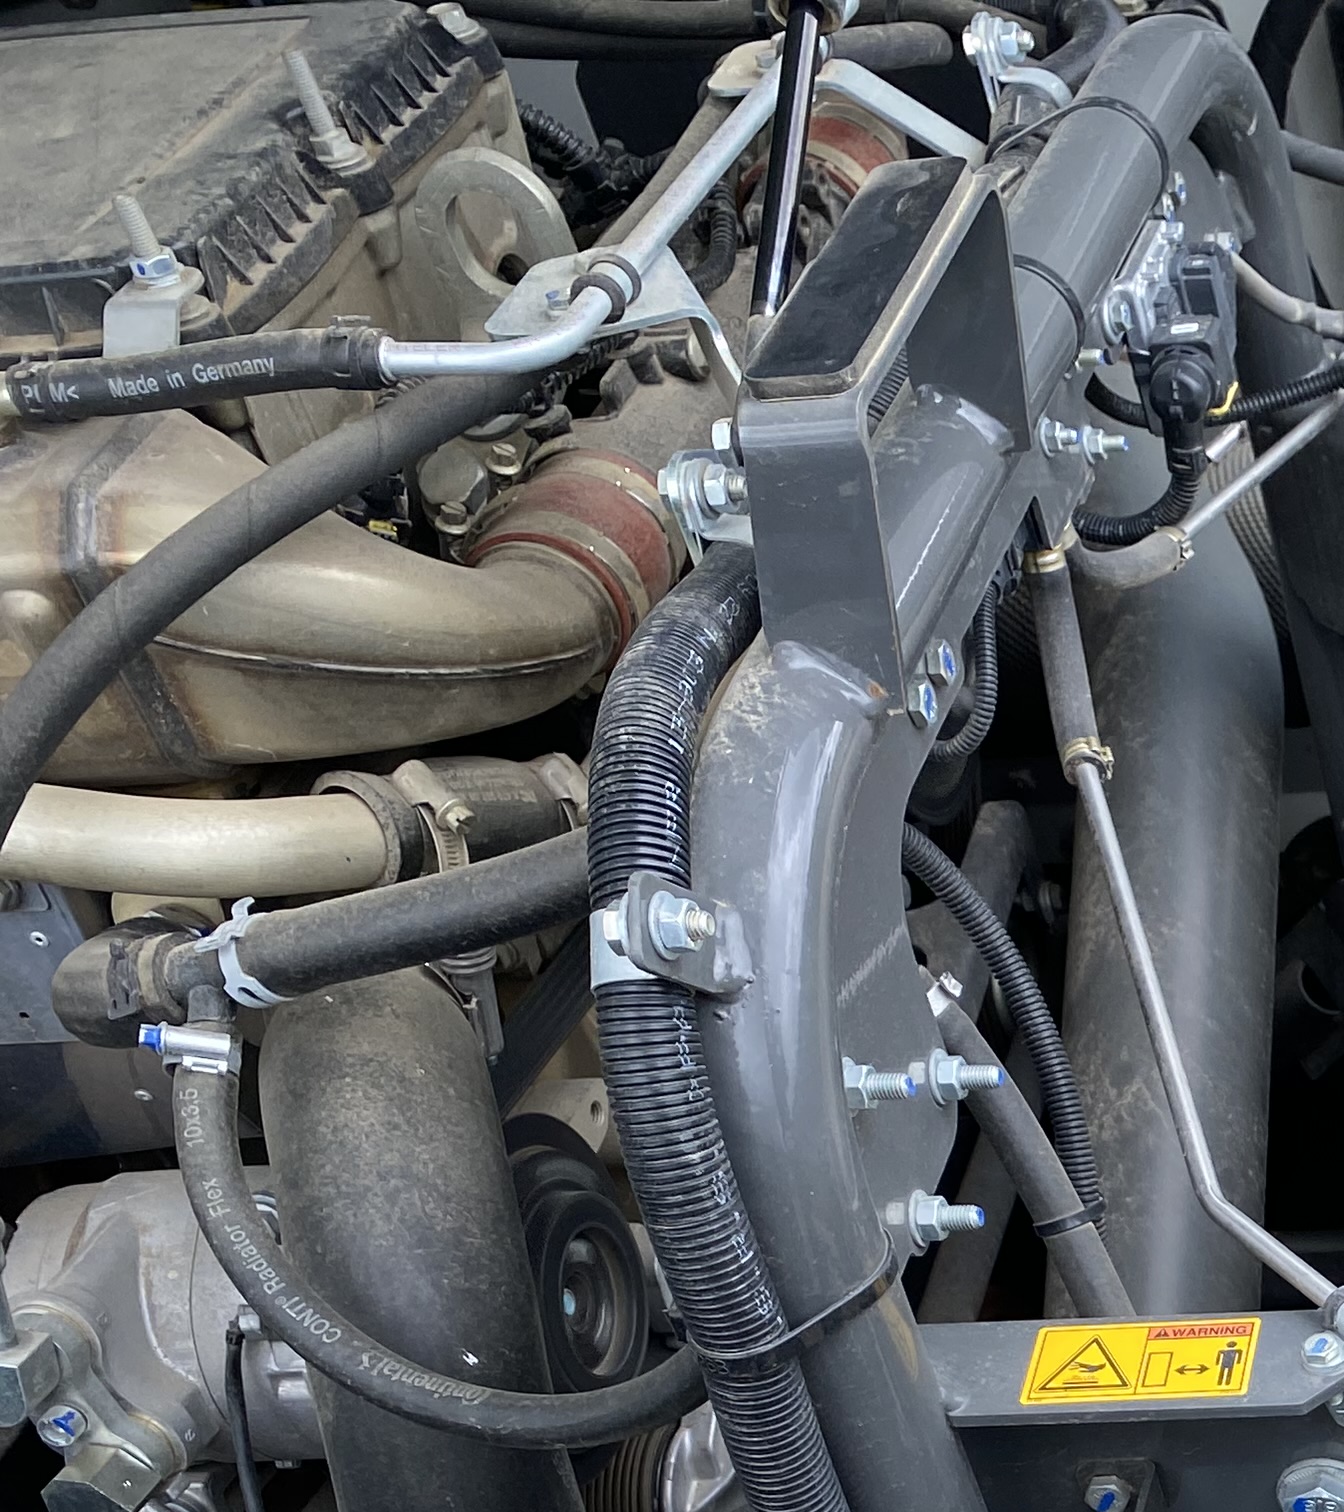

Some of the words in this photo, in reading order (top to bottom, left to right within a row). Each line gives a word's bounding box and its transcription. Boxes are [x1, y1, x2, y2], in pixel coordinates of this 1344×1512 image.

[106, 373, 160, 399] Made
[165, 369, 187, 390] in
[191, 356, 275, 384] Germany
[201, 1177, 232, 1219] Flex
[223, 1224, 287, 1295] Radiator
[1172, 1325, 1248, 1338] WARNING
[370, 1357, 491, 1405] Continental
